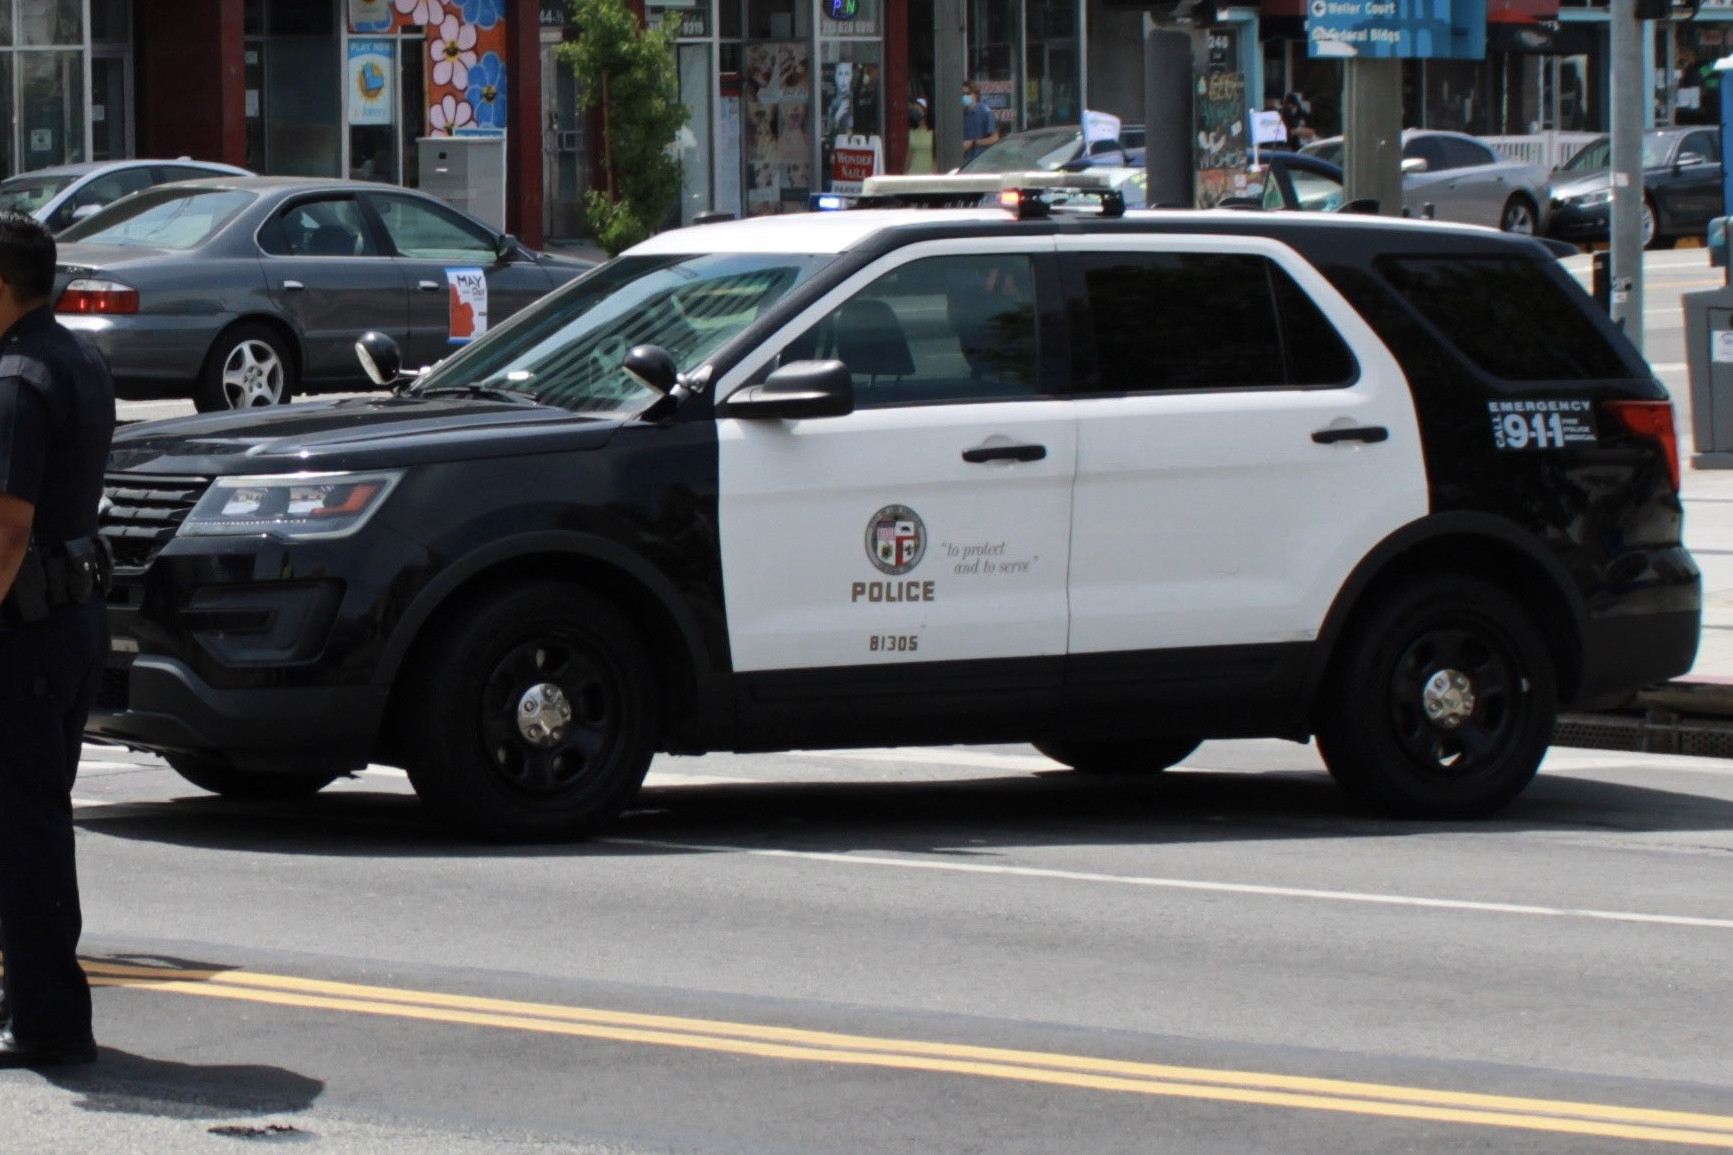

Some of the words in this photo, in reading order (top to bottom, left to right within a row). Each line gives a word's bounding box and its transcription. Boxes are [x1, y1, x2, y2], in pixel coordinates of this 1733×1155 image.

[1365, 2, 1396, 15] Court
[456, 274, 482, 288] MAY
[1488, 400, 1591, 412] EMERGENCY
[1492, 413, 1506, 448] CALL
[962, 541, 1006, 561] protect
[953, 557, 979, 574] and
[982, 558, 996, 573] to
[851, 580, 936, 603] POLICE
[869, 635, 918, 652] 81305
